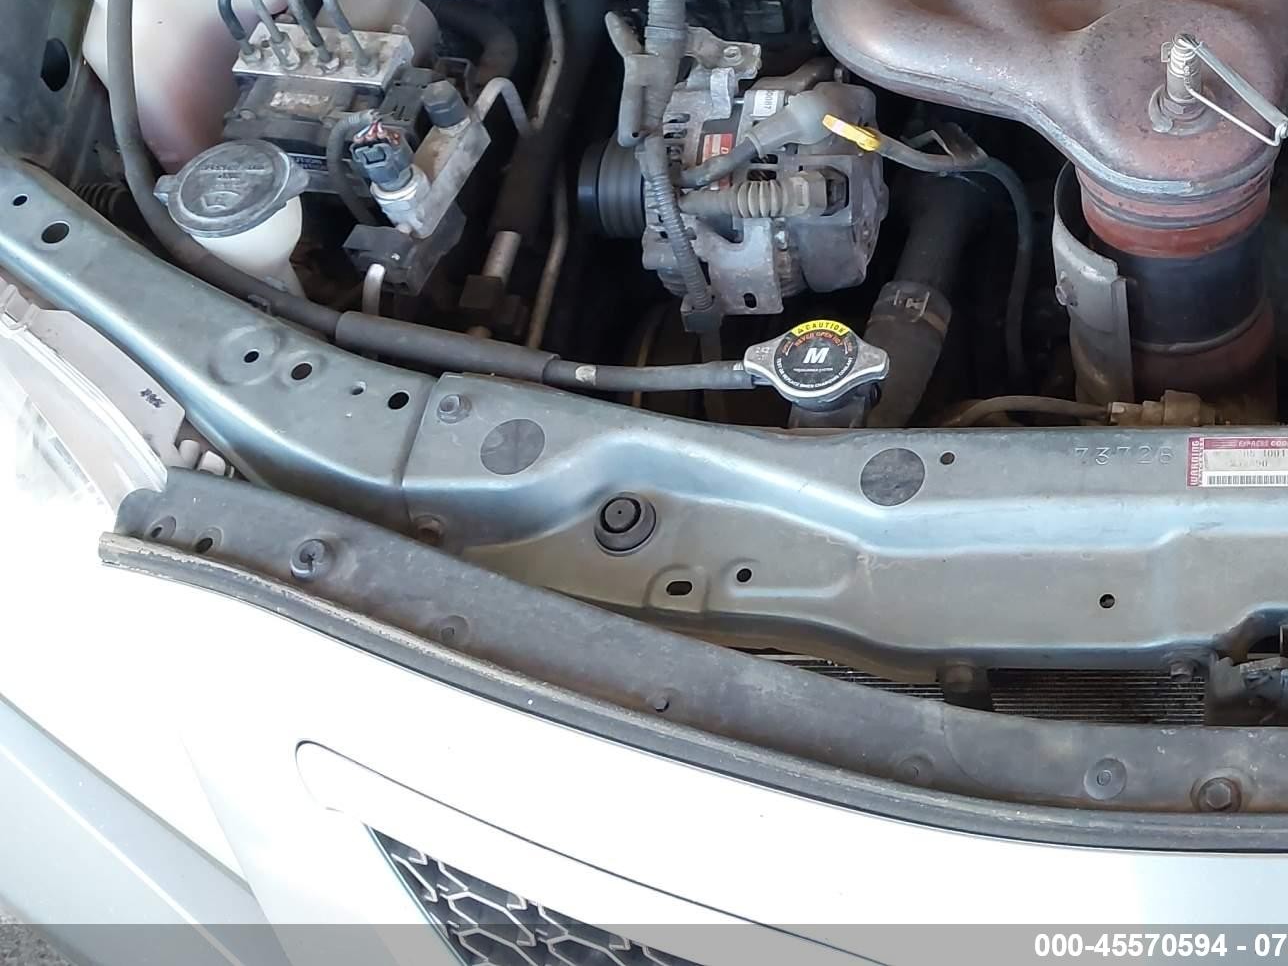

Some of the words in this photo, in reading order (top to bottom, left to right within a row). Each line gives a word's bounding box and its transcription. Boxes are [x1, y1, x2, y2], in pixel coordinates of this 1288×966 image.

[805, 322, 846, 334] CAUTION
[802, 347, 830, 364] M
[1190, 439, 1201, 485] WARNING
